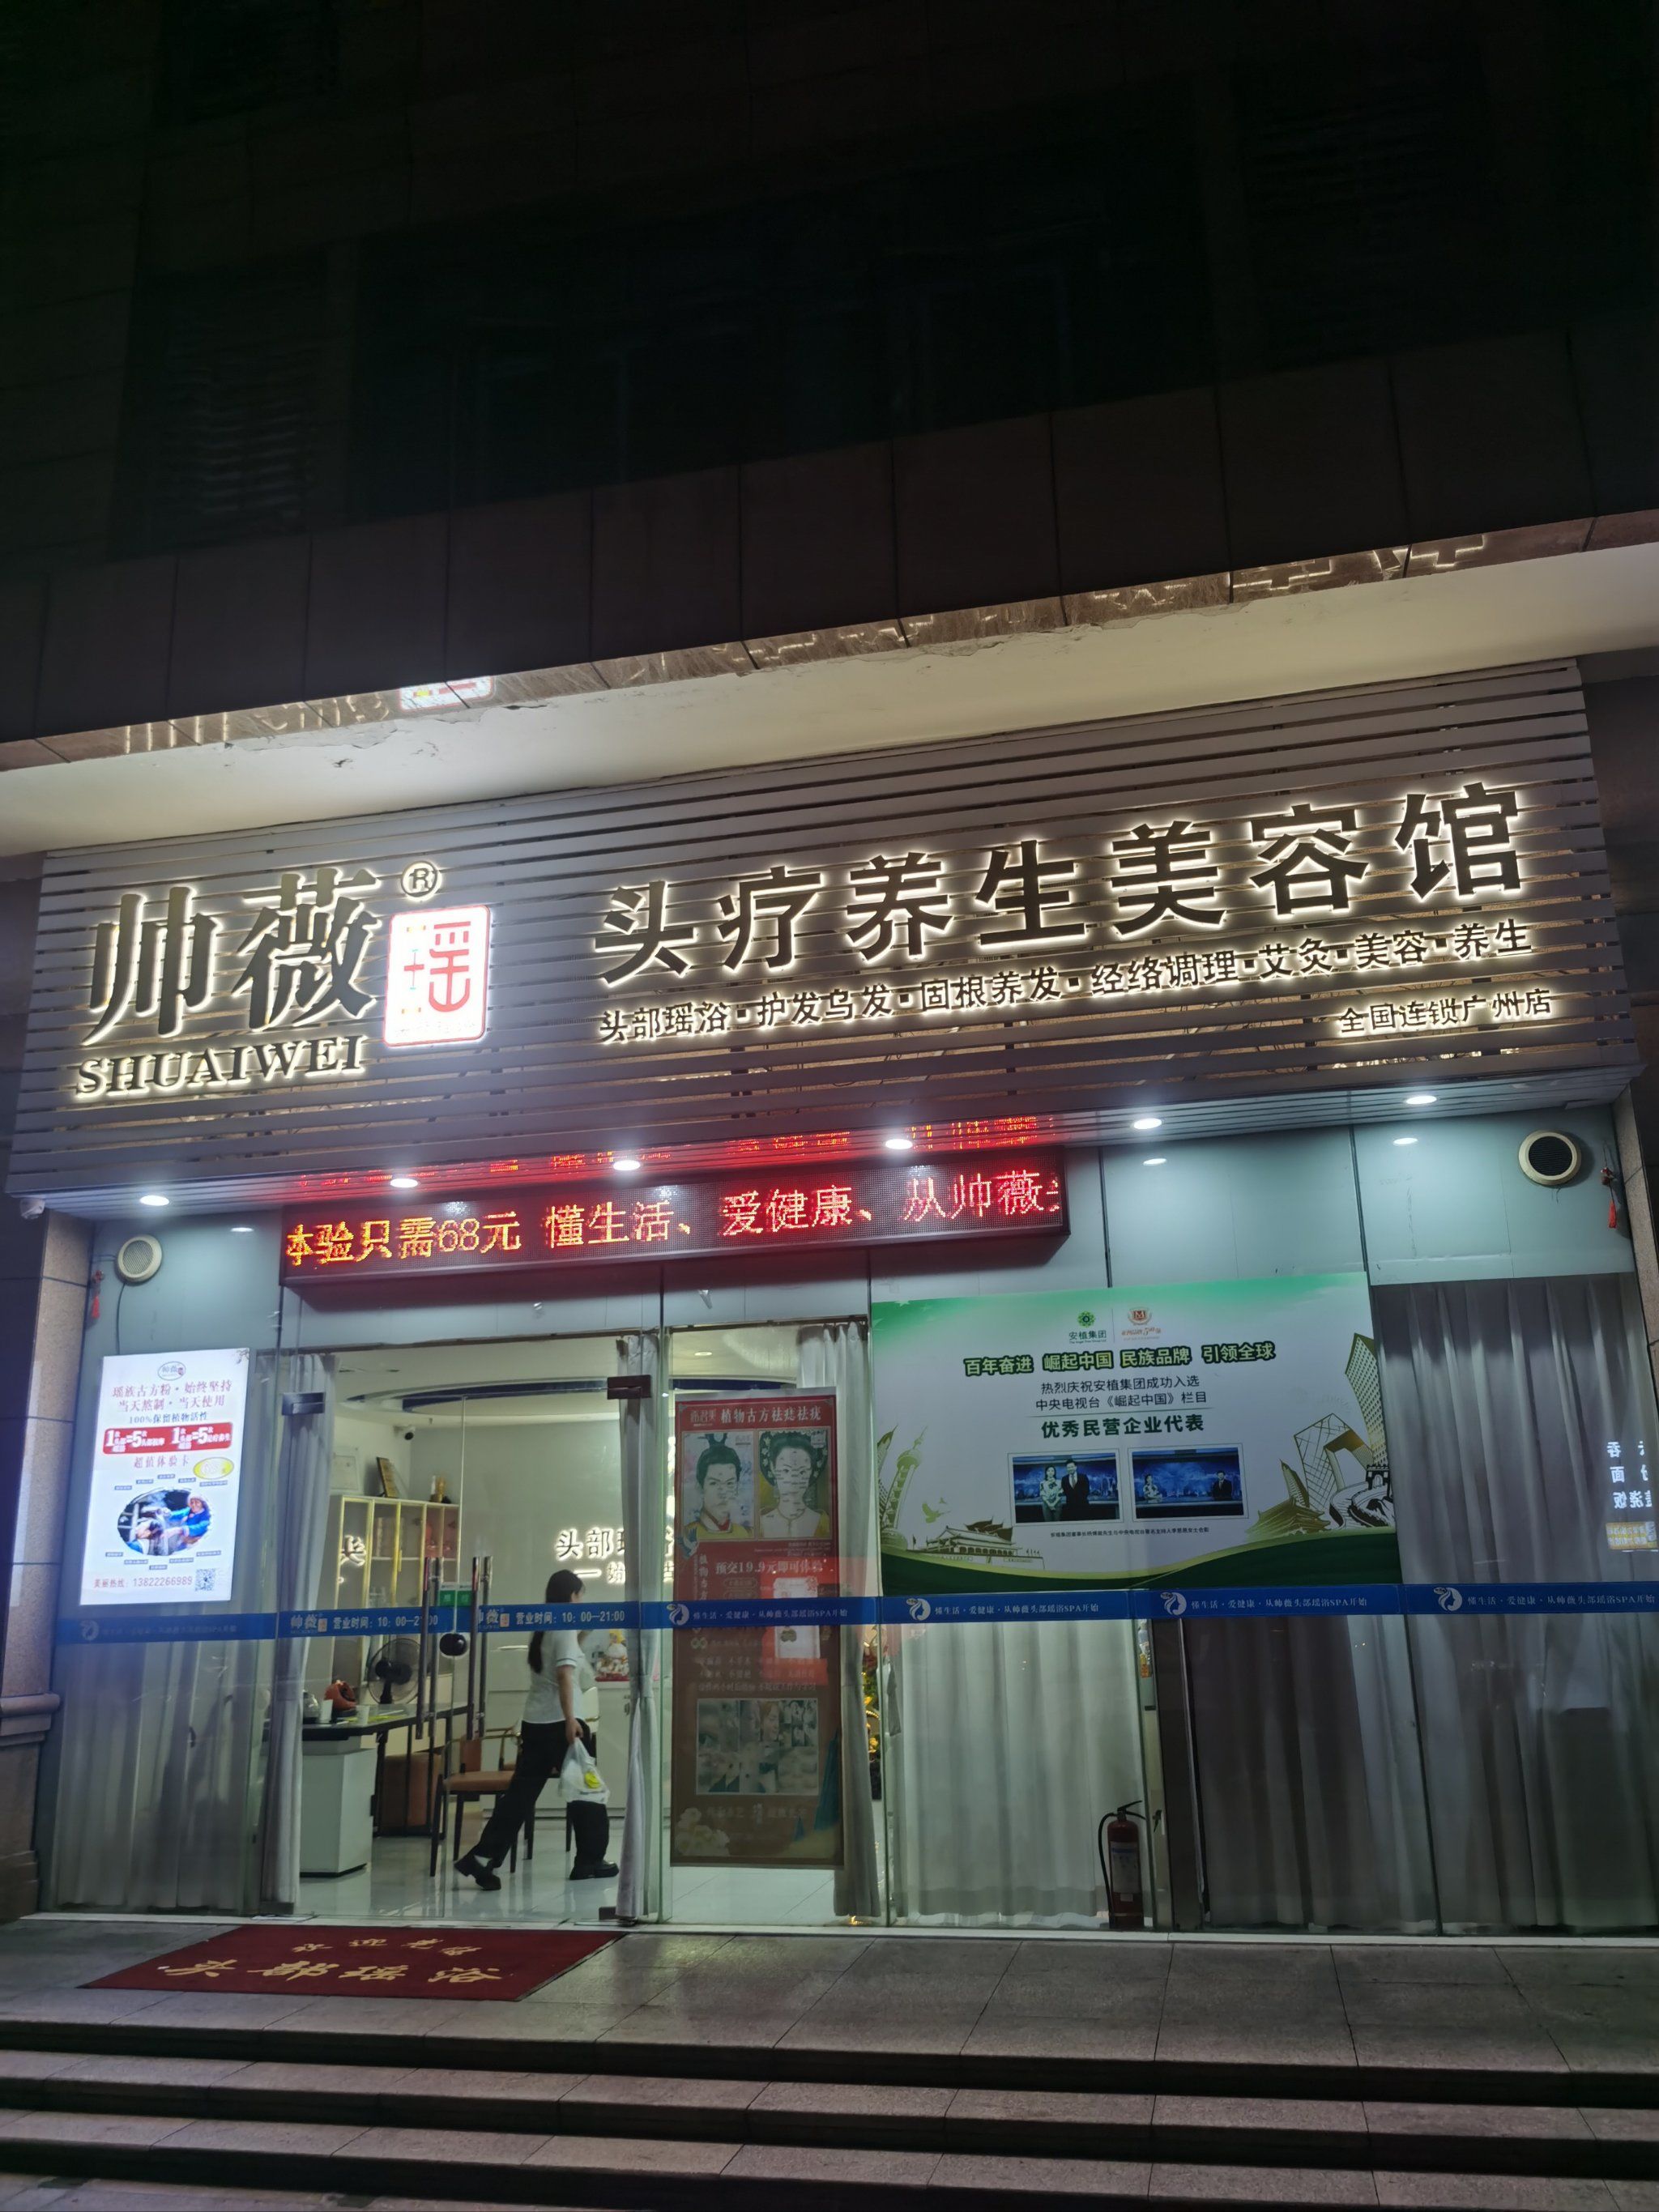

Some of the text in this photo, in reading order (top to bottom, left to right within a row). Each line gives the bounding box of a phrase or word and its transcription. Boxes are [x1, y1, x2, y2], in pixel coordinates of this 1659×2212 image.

[594, 782, 1523, 987] 头疗养生美容馆
[82, 867, 382, 1046] 帅薇
[1338, 987, 1555, 1036] 全国连锁广州店
[75, 1034, 369, 1101] SHUAIWEI
[1068, 1330, 1107, 1340] 安植集团
[964, 1341, 1276, 1376] 百年奋进 崛起中国 民族品牌 引领全球
[1035, 1392, 1207, 1412] 中央电视台《崛起中国》栏目
[1040, 1375, 1201, 1395] 热烈庆祝安植集团成功入选
[1041, 1414, 1205, 1438] 优秀民营企业代表
